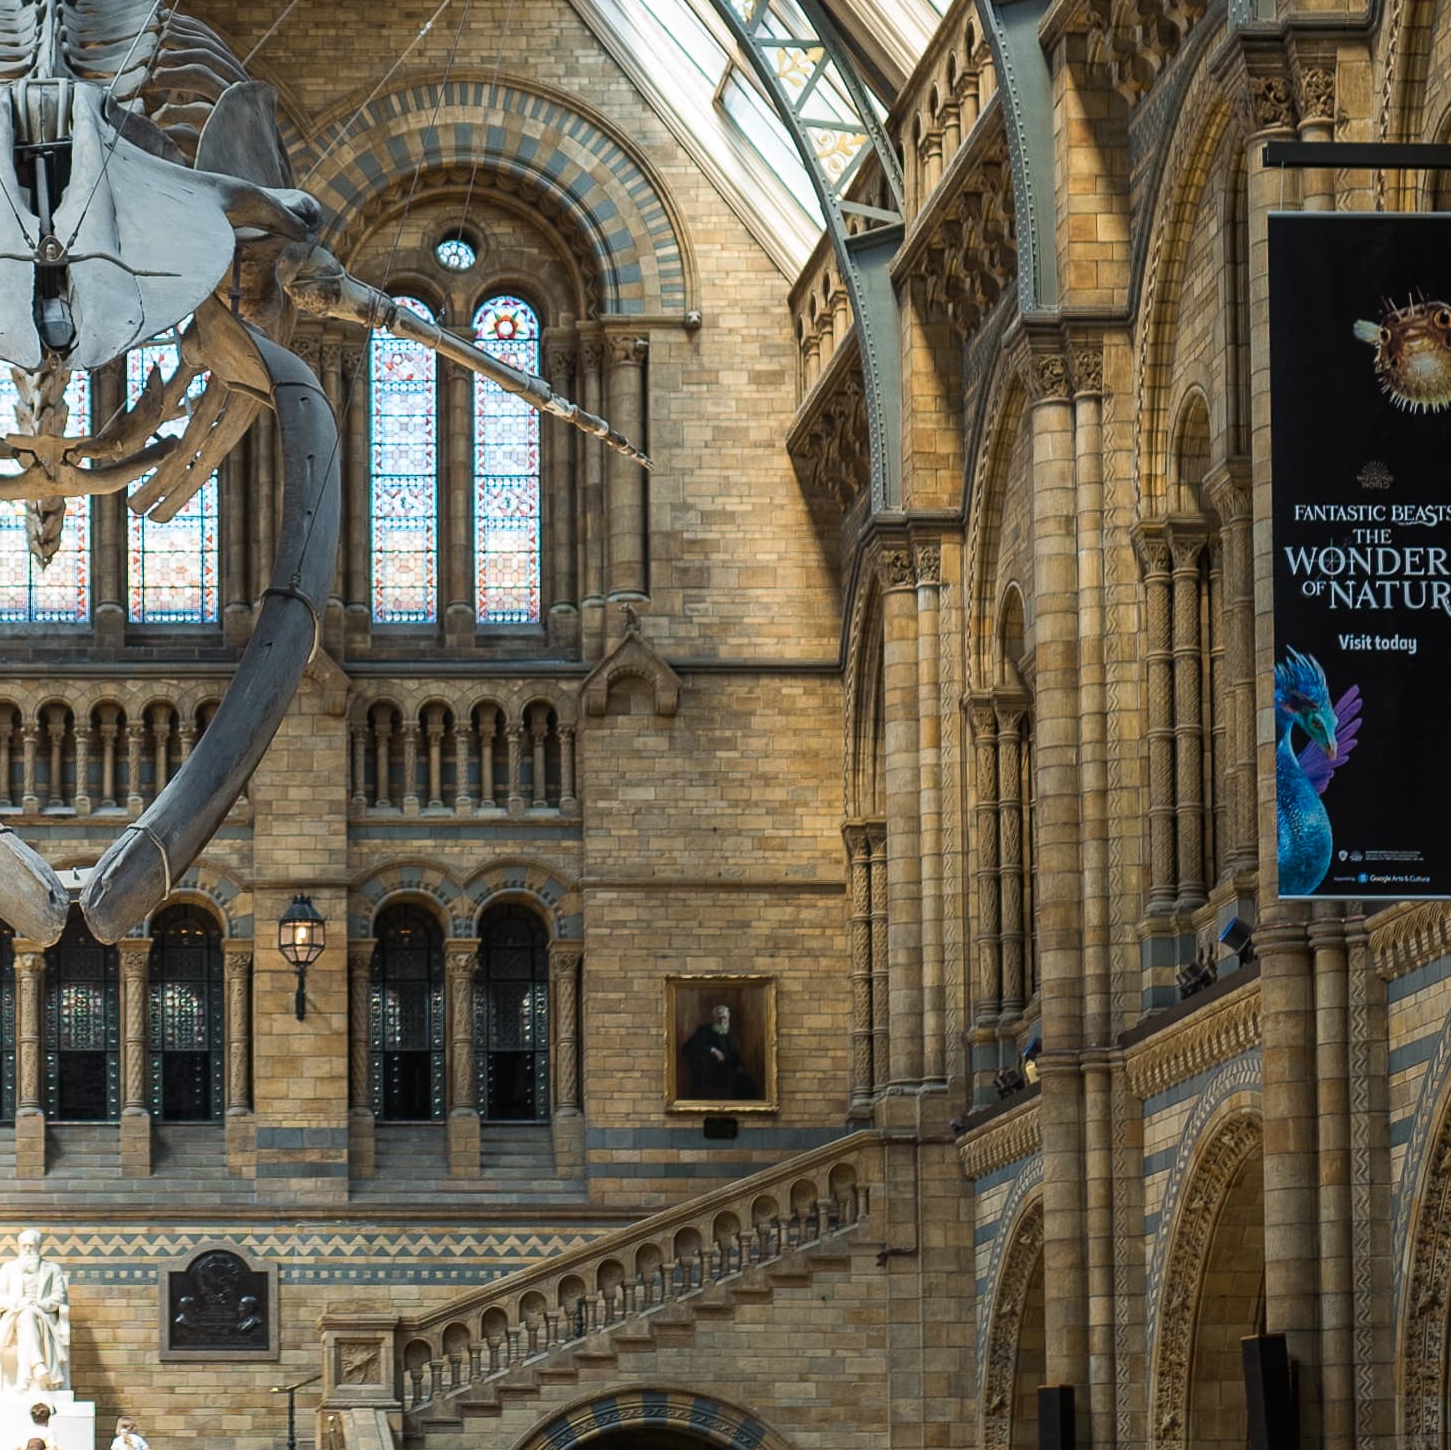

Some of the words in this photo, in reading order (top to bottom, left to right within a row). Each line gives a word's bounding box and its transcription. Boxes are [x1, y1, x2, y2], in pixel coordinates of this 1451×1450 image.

[1294, 505, 1386, 521] FANTASTIC
[1352, 528, 1392, 544] THE
[1302, 580, 1326, 596] OF
[1338, 634, 1372, 650] Visit
[1375, 634, 1417, 654] today
